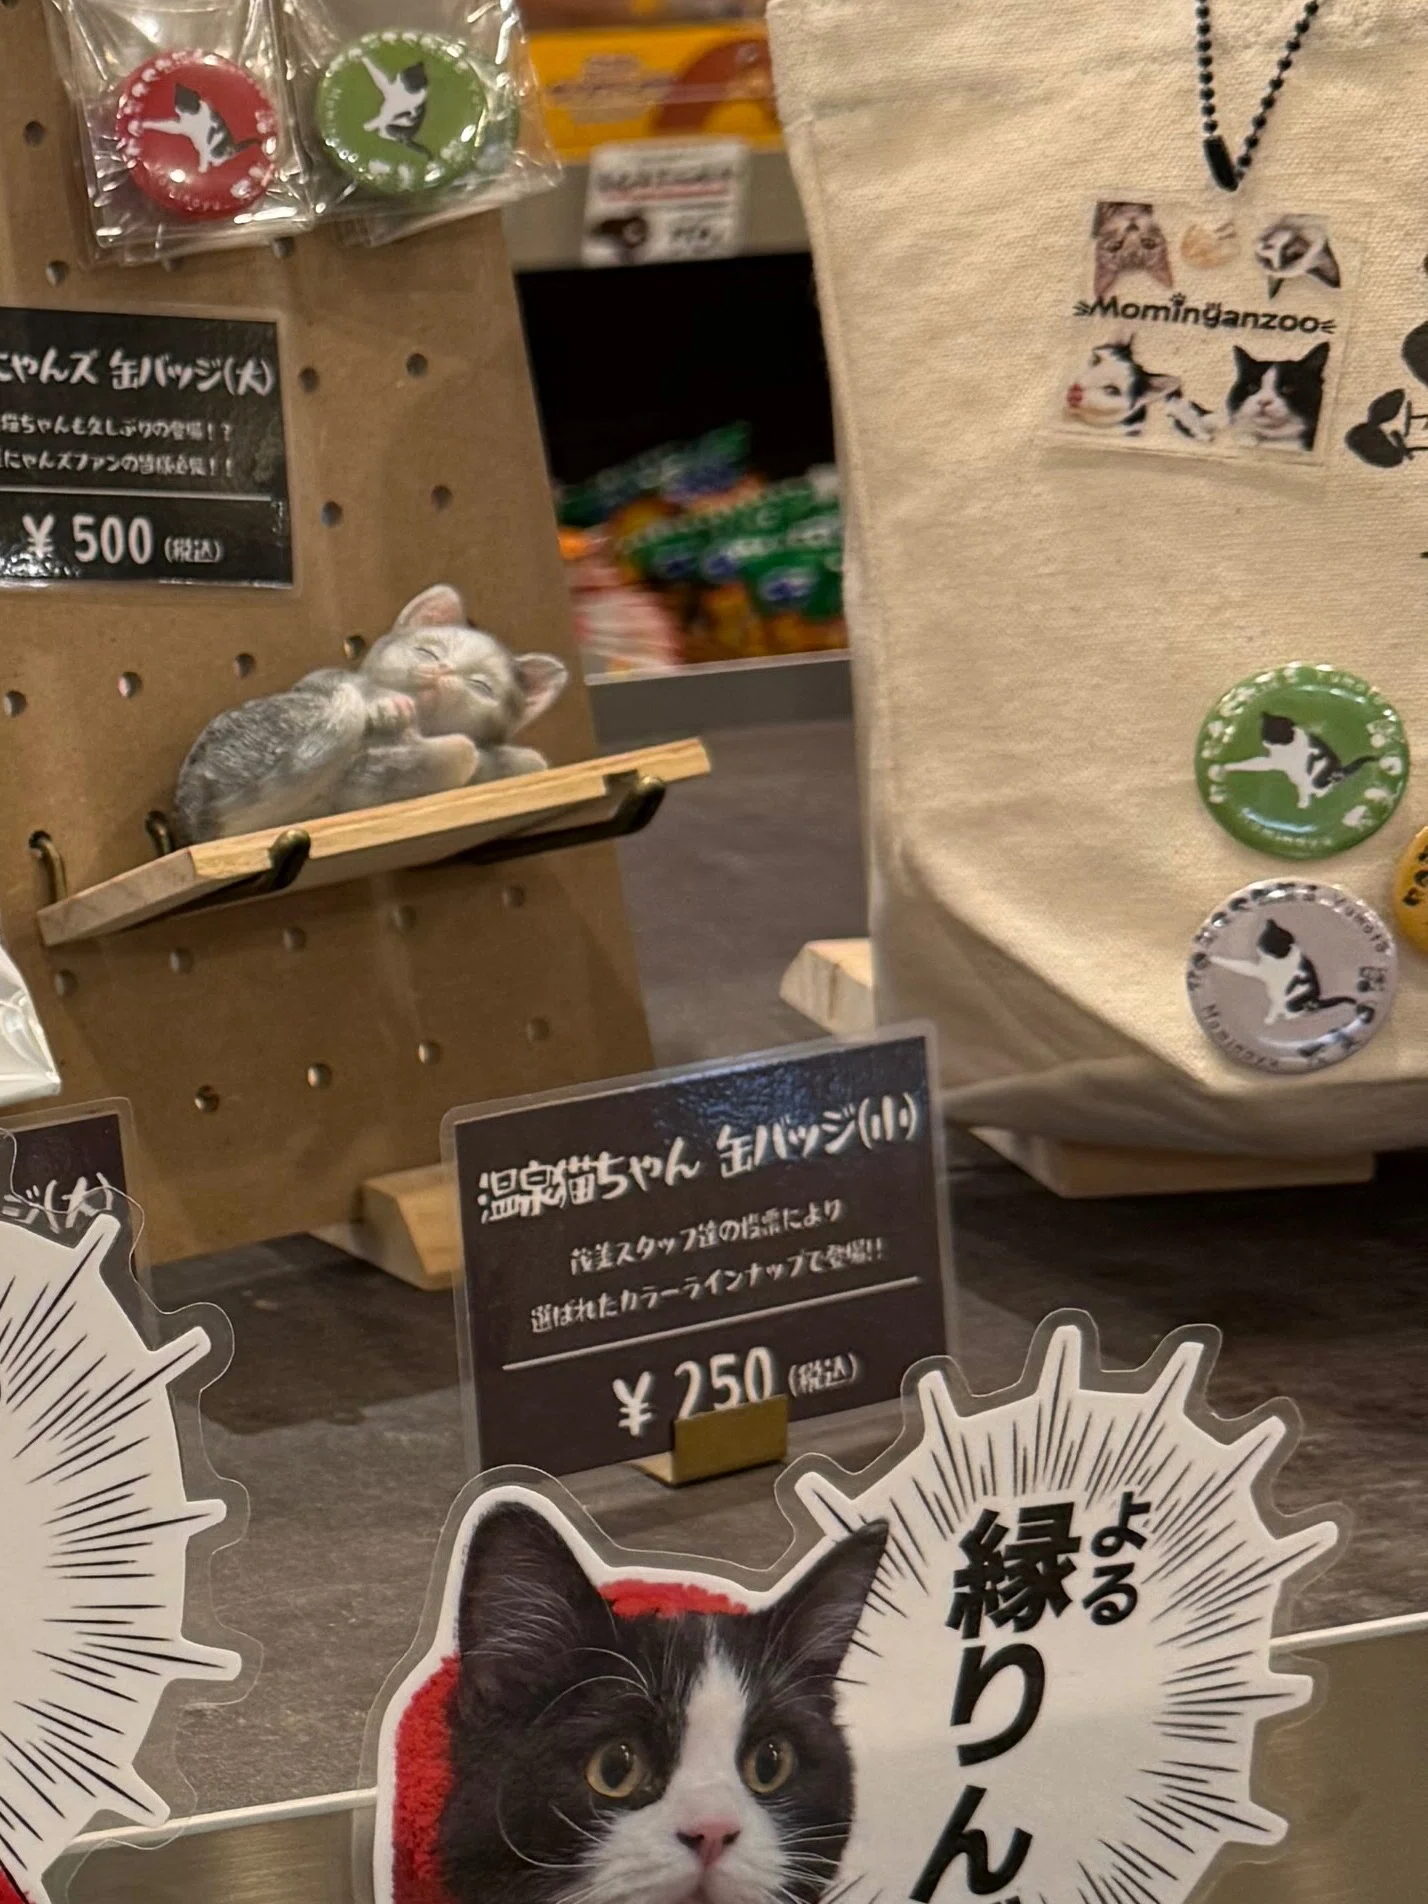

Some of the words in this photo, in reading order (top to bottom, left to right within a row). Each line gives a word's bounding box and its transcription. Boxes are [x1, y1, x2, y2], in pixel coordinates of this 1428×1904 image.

[109, 347, 275, 397] 缶バッジ(大)
[72, 512, 154, 565] 500
[477, 1137, 702, 1224] 温泉猫ちゃん
[715, 1092, 918, 1180] 缶バッジ(小)
[674, 1345, 775, 1420] 250
[1082, 1490, 1153, 1627] よる
